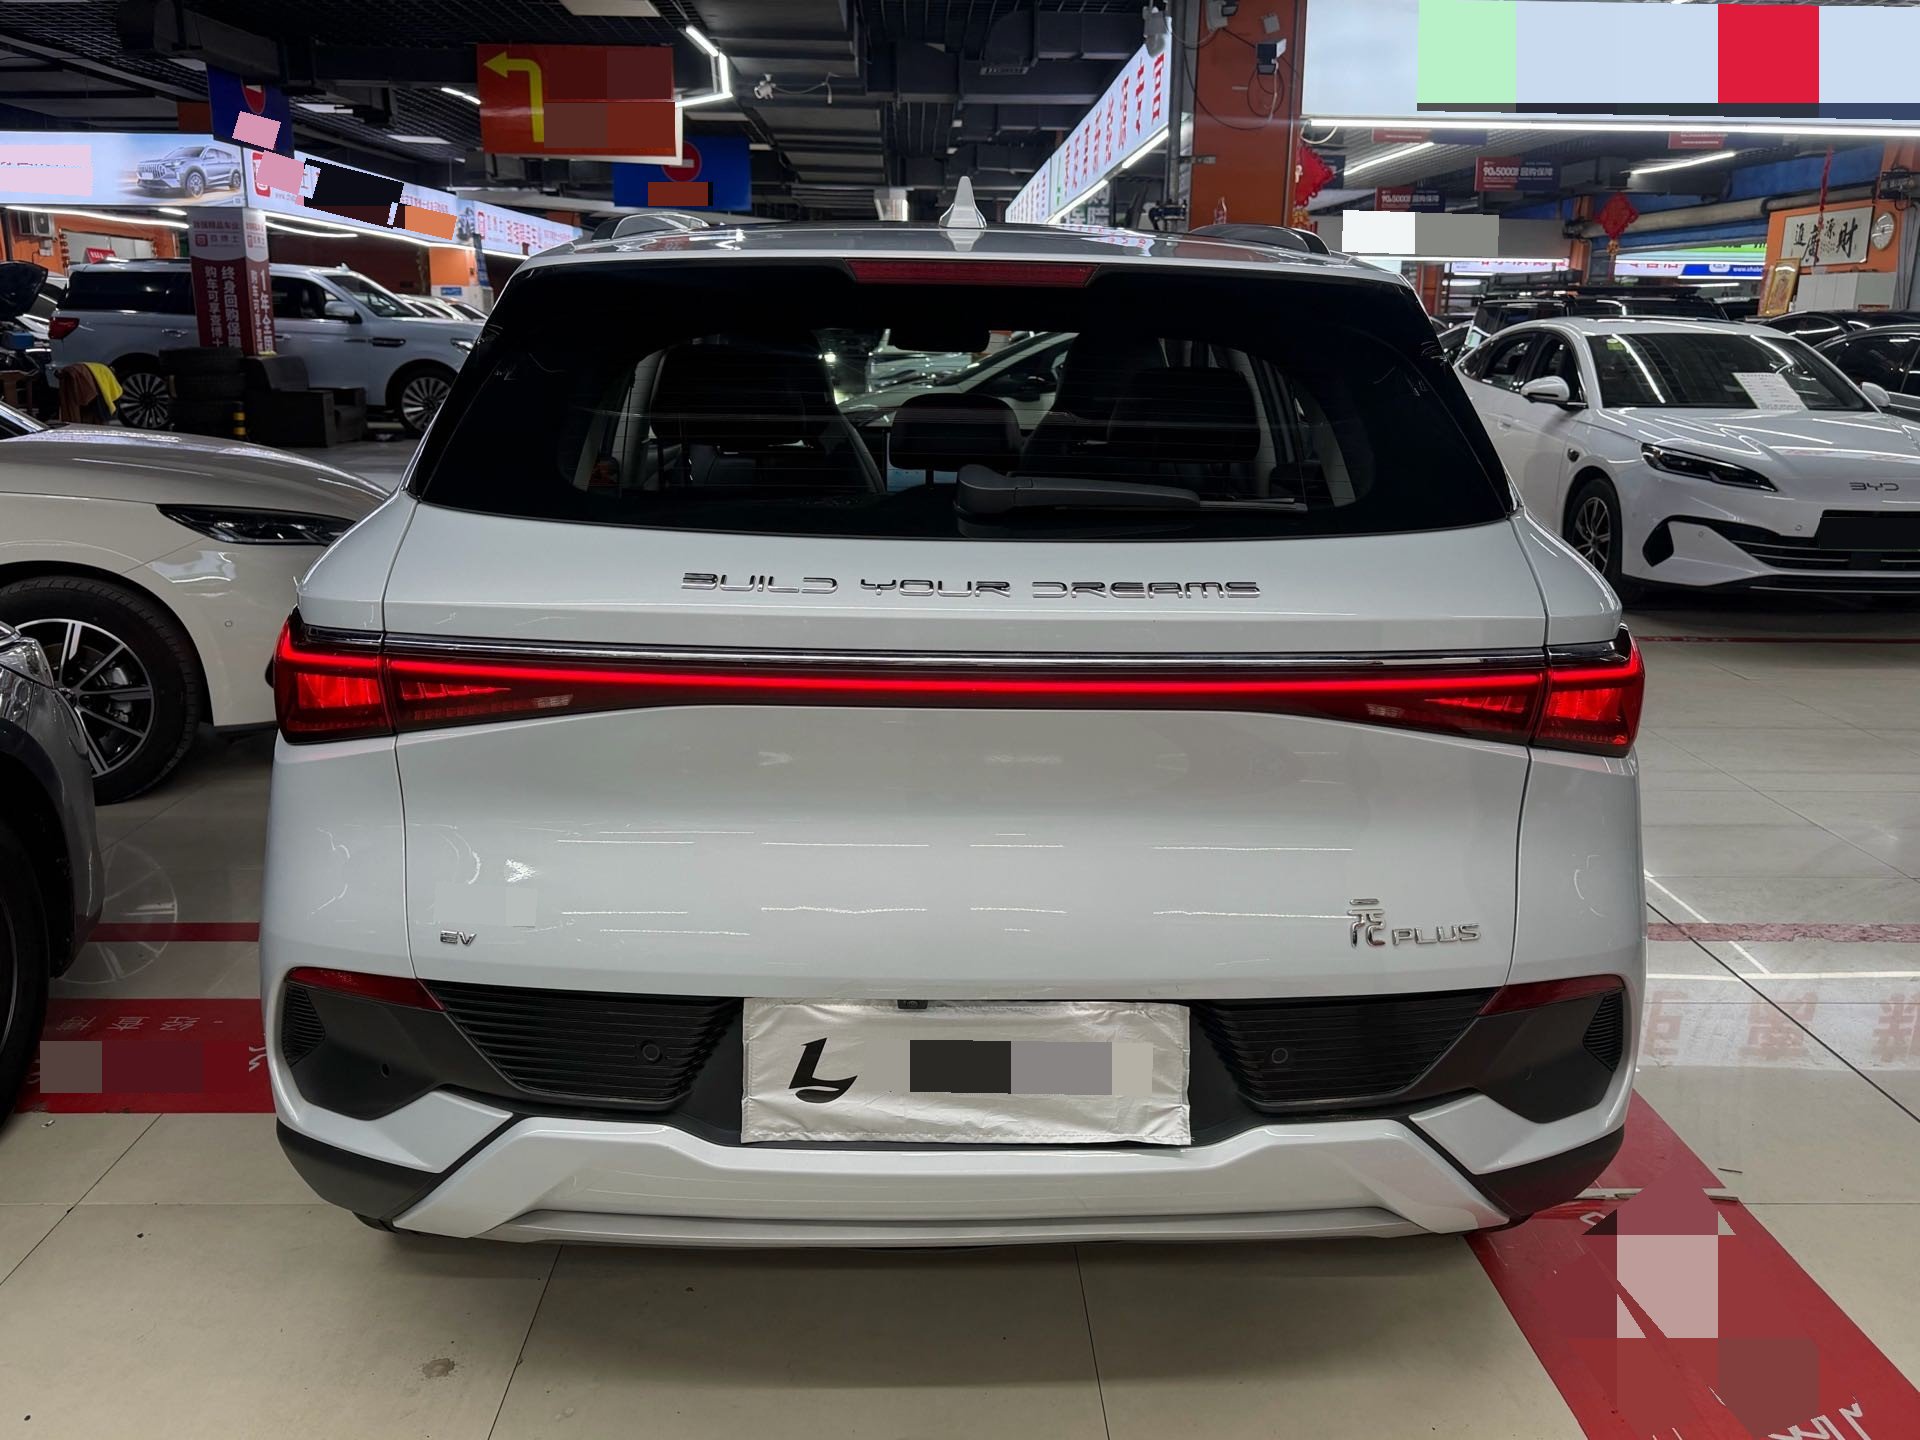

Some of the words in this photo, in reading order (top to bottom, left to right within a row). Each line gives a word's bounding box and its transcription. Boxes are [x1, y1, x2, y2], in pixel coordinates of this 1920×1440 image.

[1849, 482, 1900, 492] BYD
[681, 571, 839, 594] BUILD
[860, 577, 1011, 598] YOUR
[1032, 580, 1262, 600] DREAMS
[439, 930, 477, 947] EV
[1391, 923, 1481, 947] PLUS
